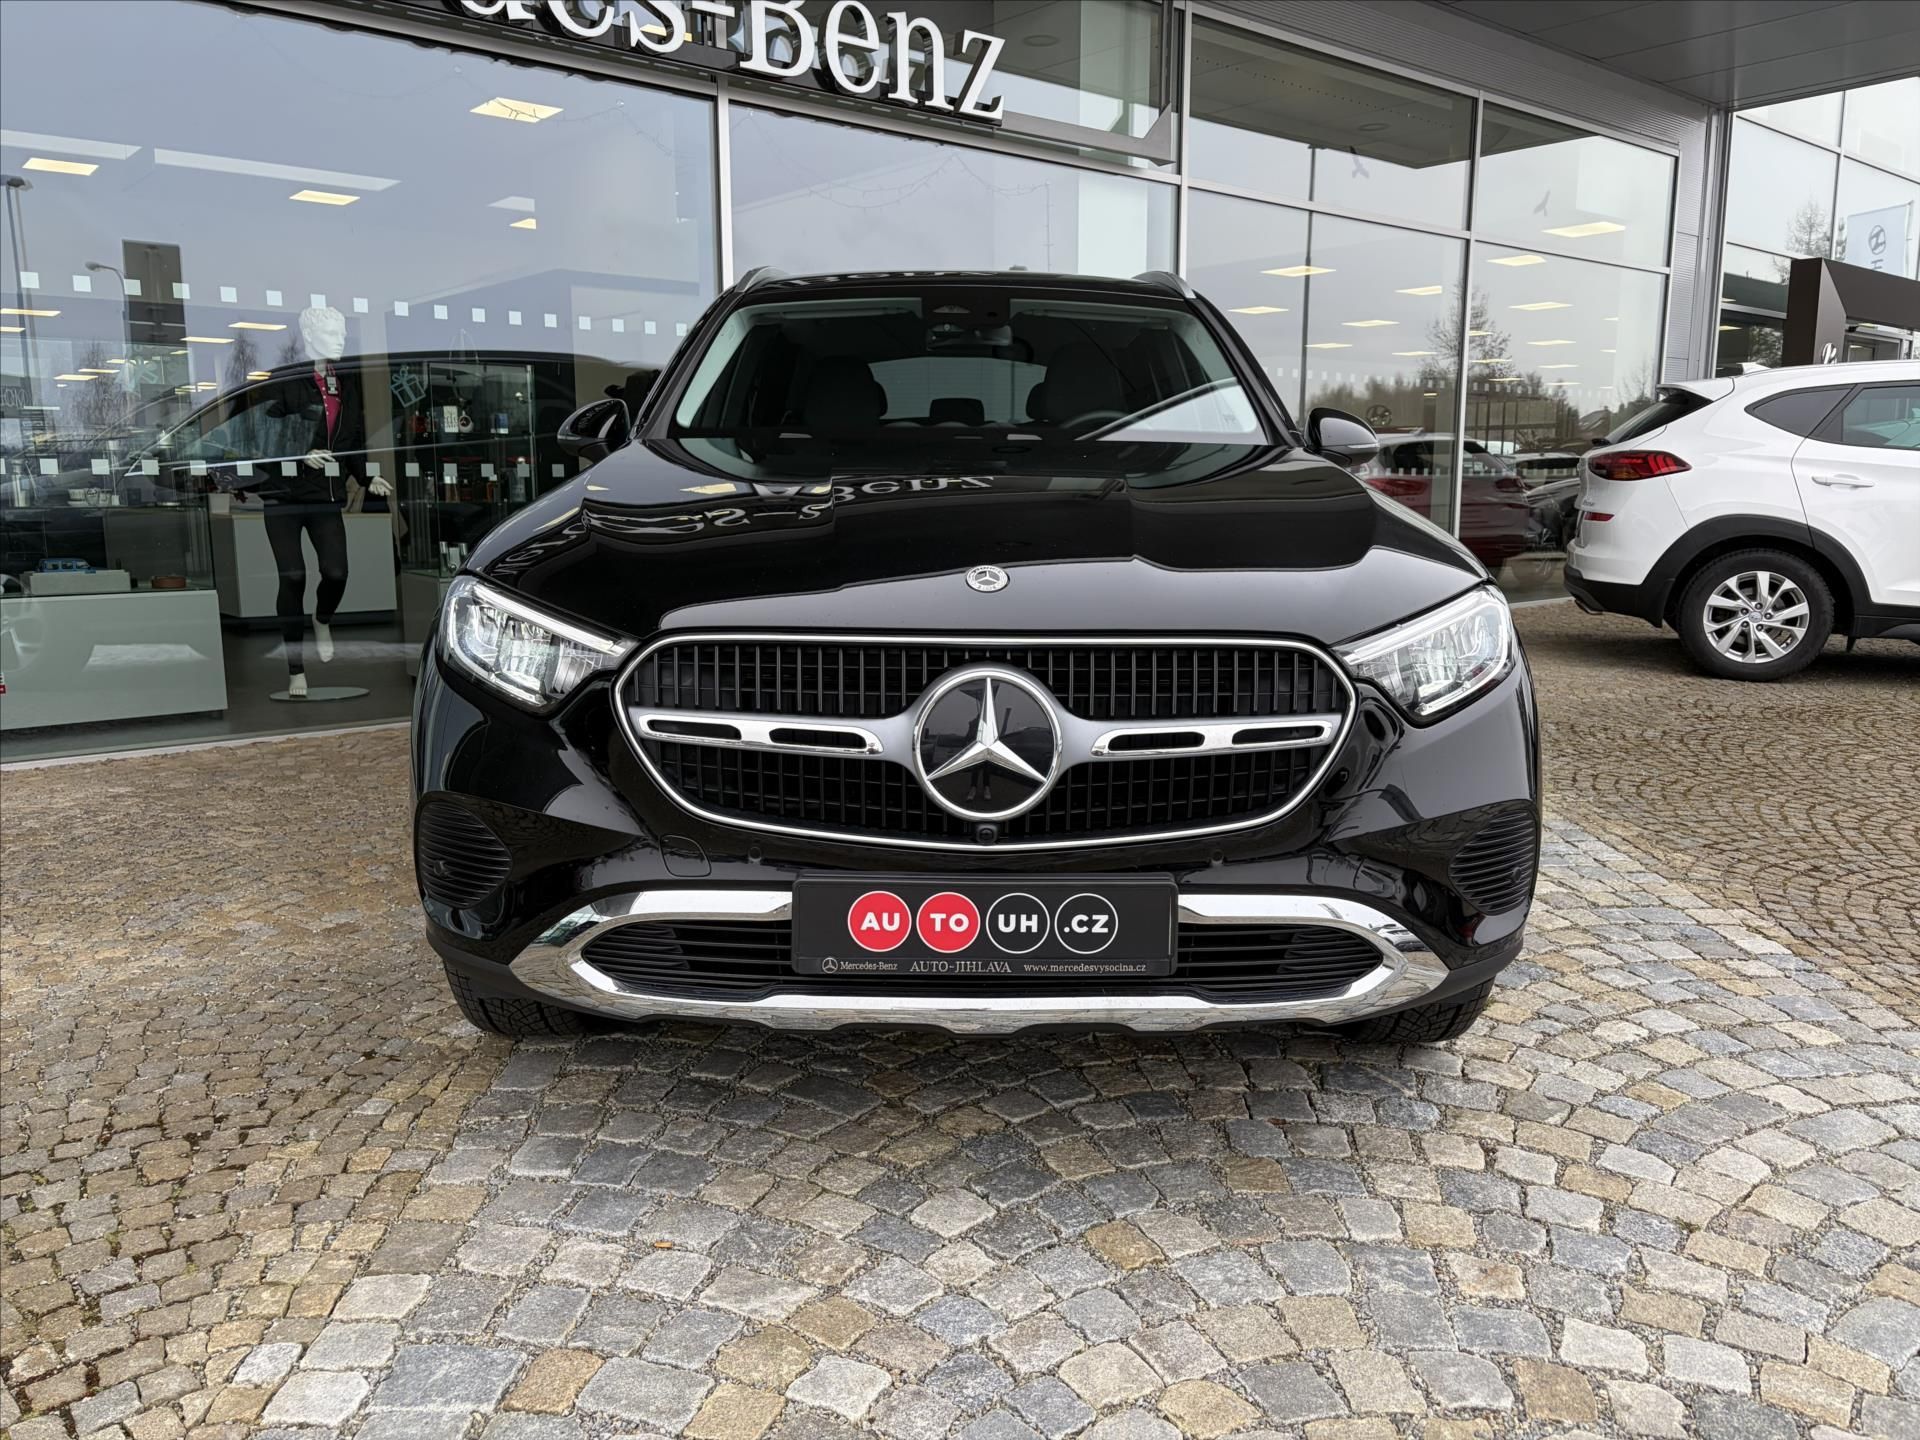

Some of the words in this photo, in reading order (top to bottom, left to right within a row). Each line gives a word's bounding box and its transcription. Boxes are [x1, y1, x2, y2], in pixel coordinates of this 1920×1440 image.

[840, 961, 898, 973] Mercedes-Benz
[910, 961, 1012, 974] AUTO-JIHLAVA
[1024, 963, 1147, 974] www.mercedesvysocina.cz
